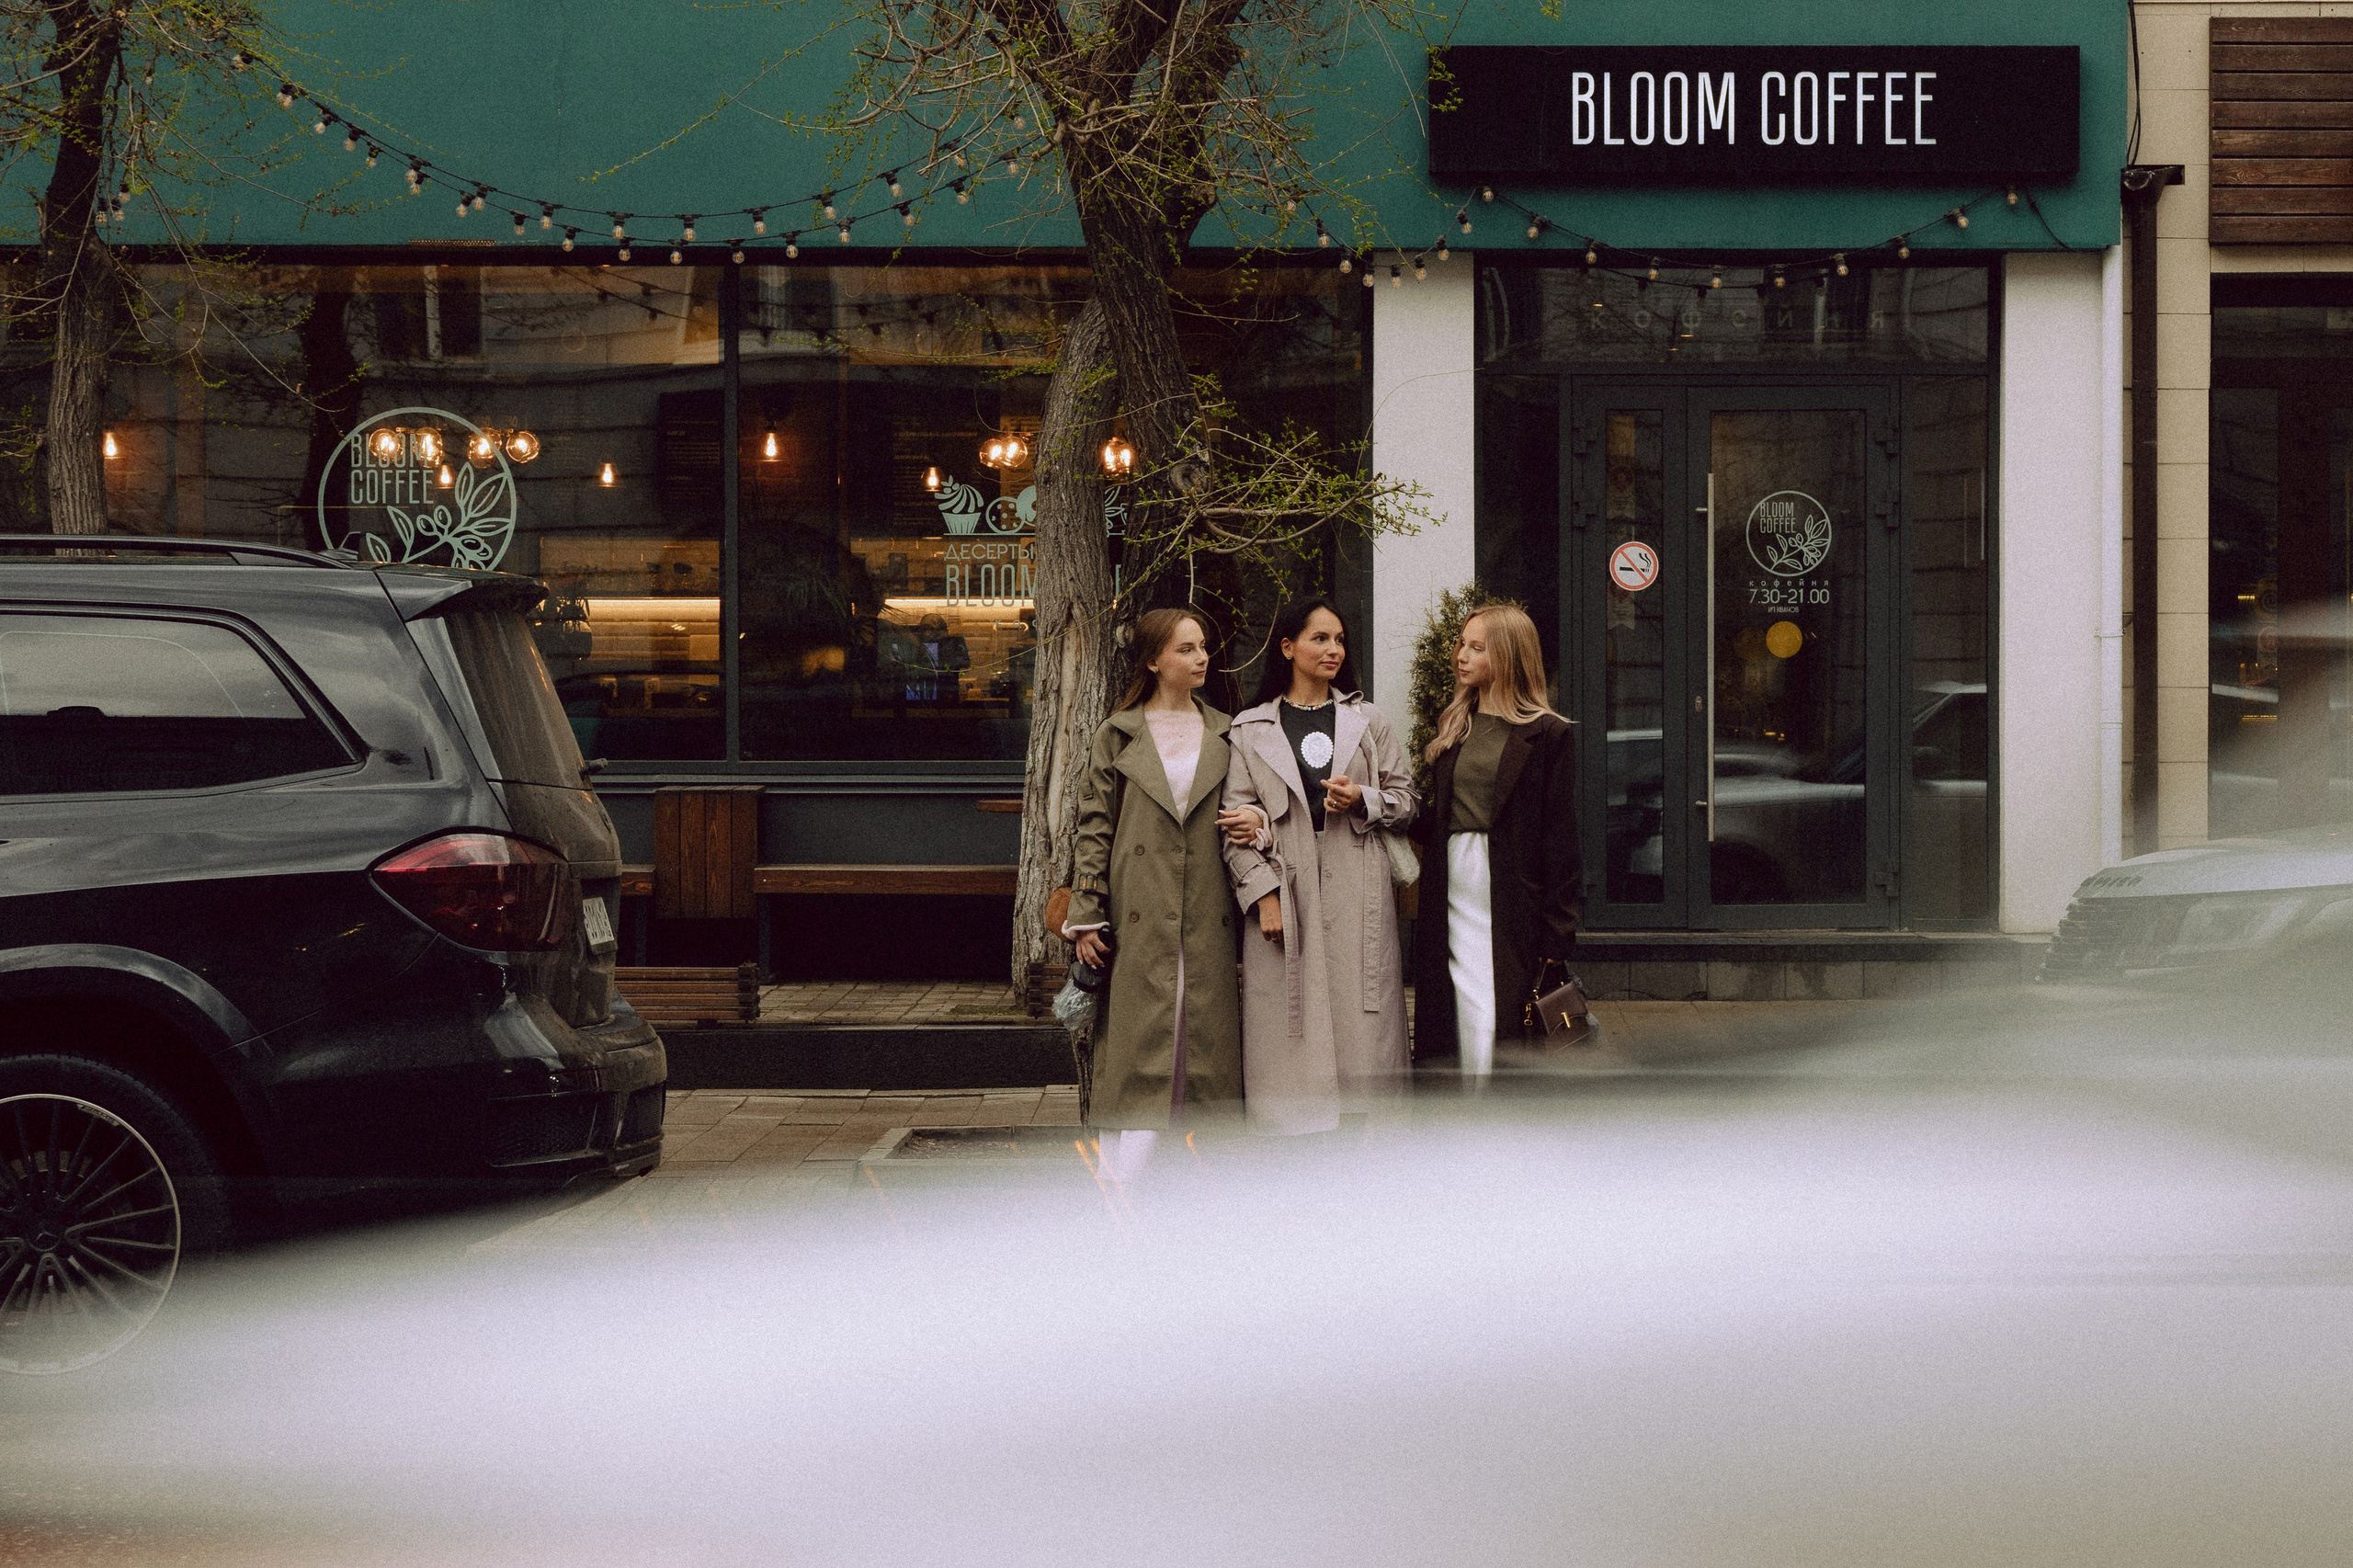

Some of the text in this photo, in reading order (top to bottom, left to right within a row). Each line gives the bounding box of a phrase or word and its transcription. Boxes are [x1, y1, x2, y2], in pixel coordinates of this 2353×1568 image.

[1572, 71, 1937, 145] BLOOM COFFEE
[351, 433, 428, 468] BLOOM
[350, 469, 434, 505] COFFEE
[1760, 502, 1794, 517] BLOOM
[1759, 517, 1796, 533] COFFEE
[943, 543, 1034, 561] ДЕСЕРТЫ
